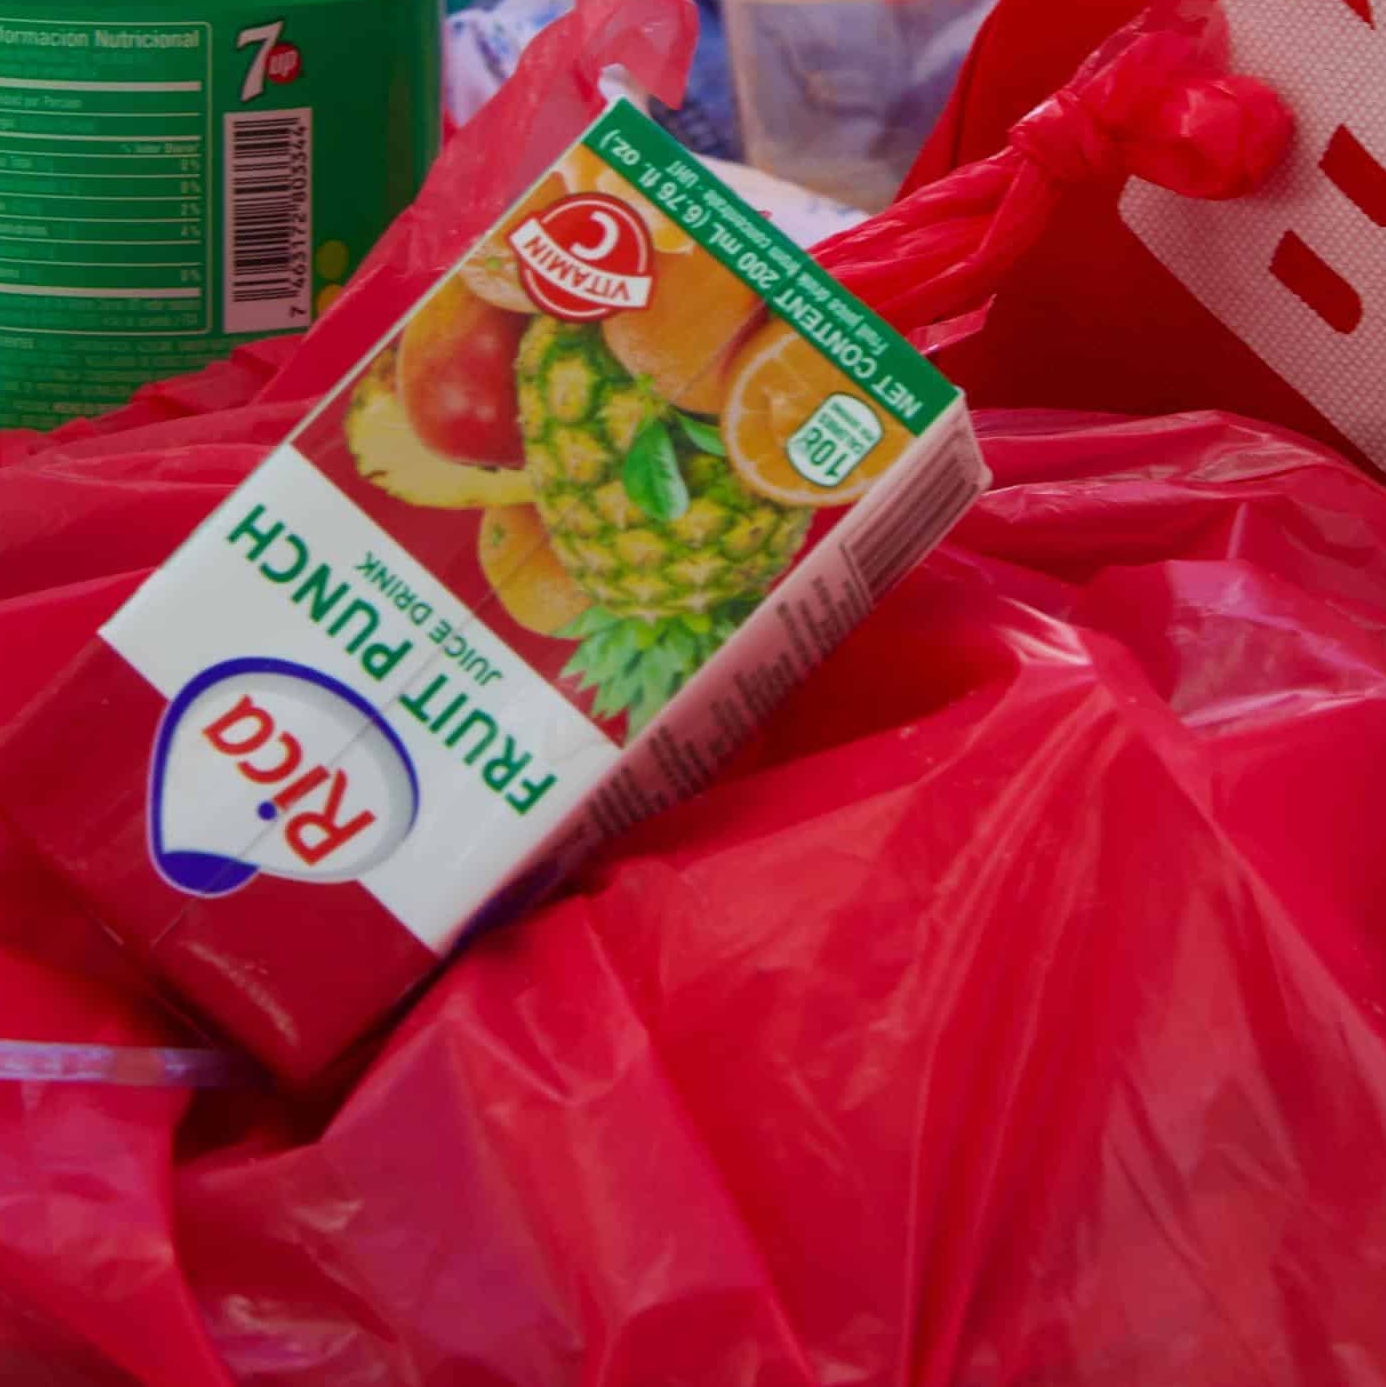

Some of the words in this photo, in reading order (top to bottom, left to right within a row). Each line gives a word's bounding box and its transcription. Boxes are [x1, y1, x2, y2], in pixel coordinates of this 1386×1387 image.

[94, 29, 200, 49] Nutricional
[599, 129, 641, 166] oz.)
[656, 181, 712, 229] (6.76
[708, 222, 745, 255] mL
[523, 235, 631, 302] VITAMIN
[738, 252, 780, 289] 200
[773, 288, 878, 379] CONTENT
[871, 375, 924, 418] NET
[225, 503, 414, 682] PUNCH
[354, 551, 435, 627] DRINK
[427, 618, 503, 687] JUICE
[397, 673, 558, 816] FRUIT
[201, 694, 377, 867] Rica
